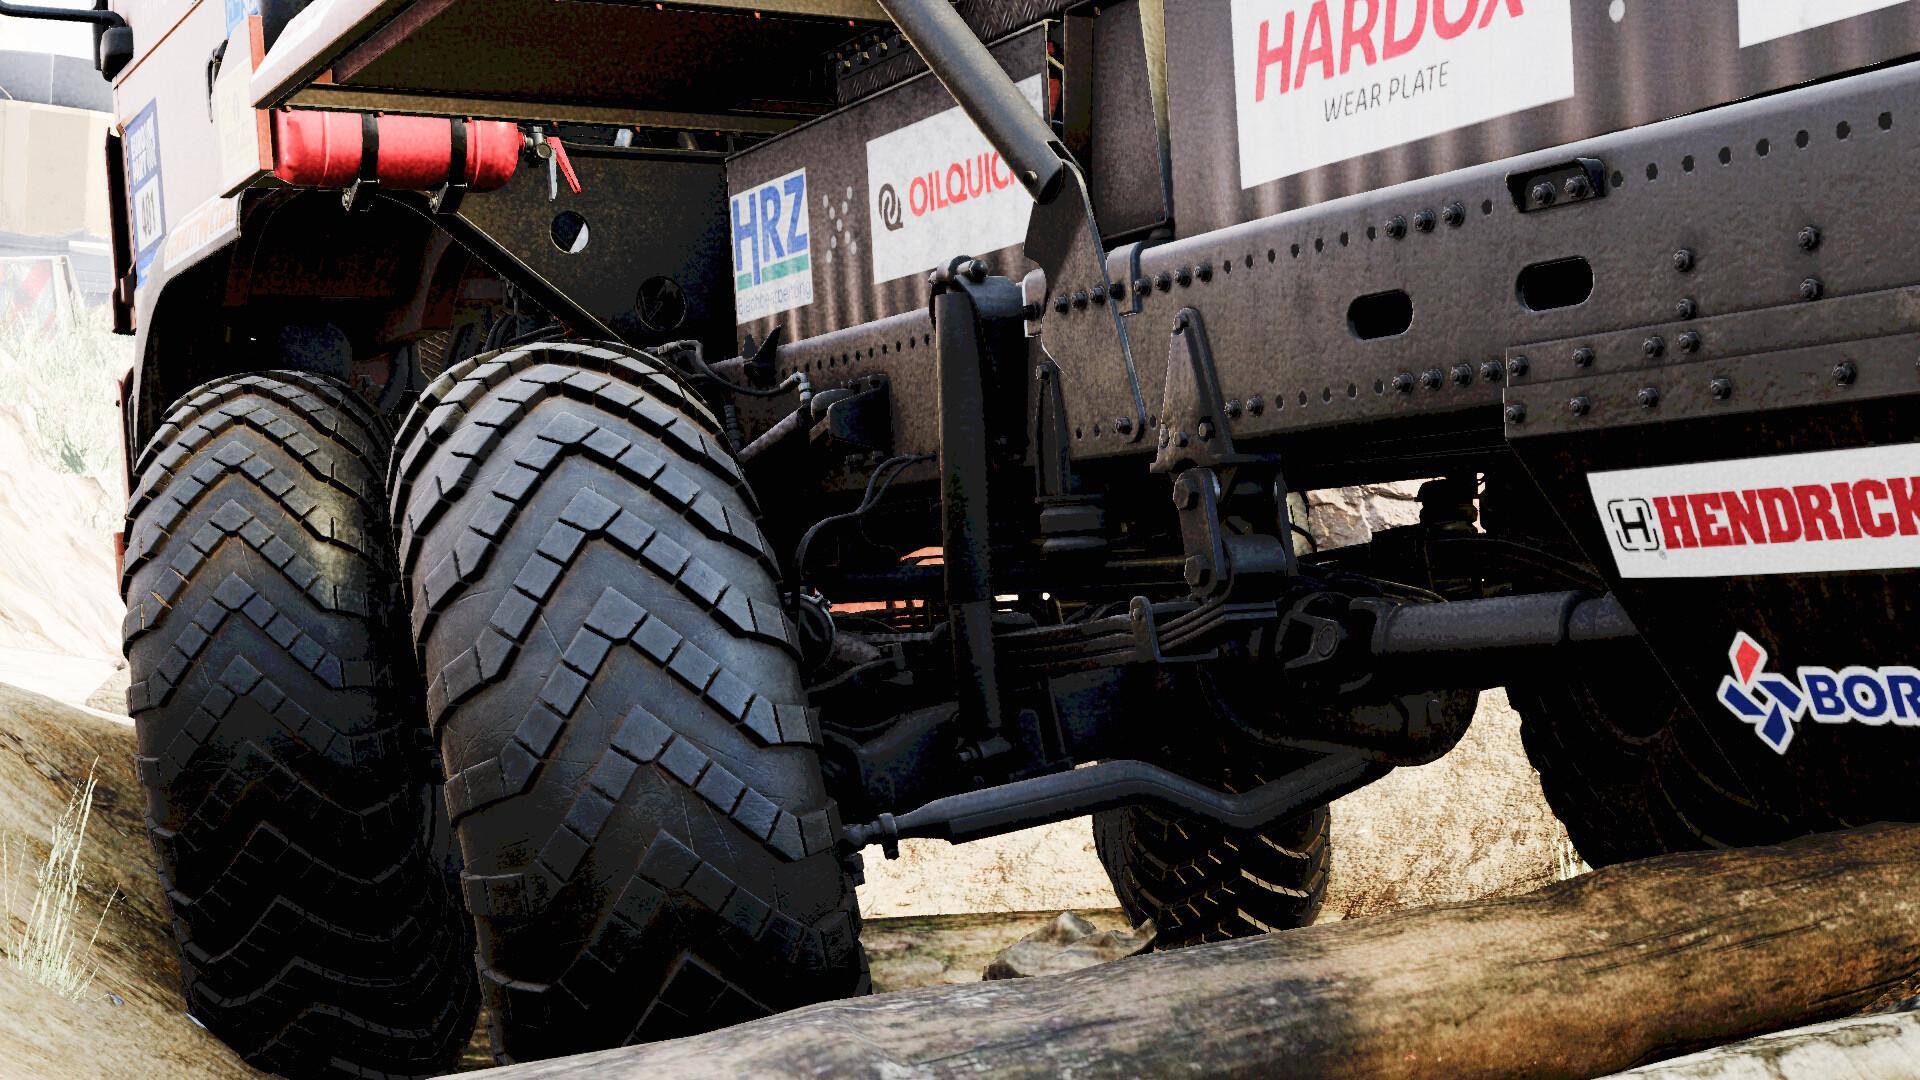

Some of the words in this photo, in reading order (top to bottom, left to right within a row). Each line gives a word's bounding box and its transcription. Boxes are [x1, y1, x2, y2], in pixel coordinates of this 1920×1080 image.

[1256, 0, 1524, 103] HARDO
[1323, 82, 1382, 122] WEAR
[1388, 61, 1449, 104] PLATE
[141, 190, 157, 239] 401
[909, 150, 1015, 217] OILQUIC
[732, 174, 808, 286] HRZ
[1652, 477, 1920, 550] HENDRICK
[1804, 674, 1920, 718] BOR
